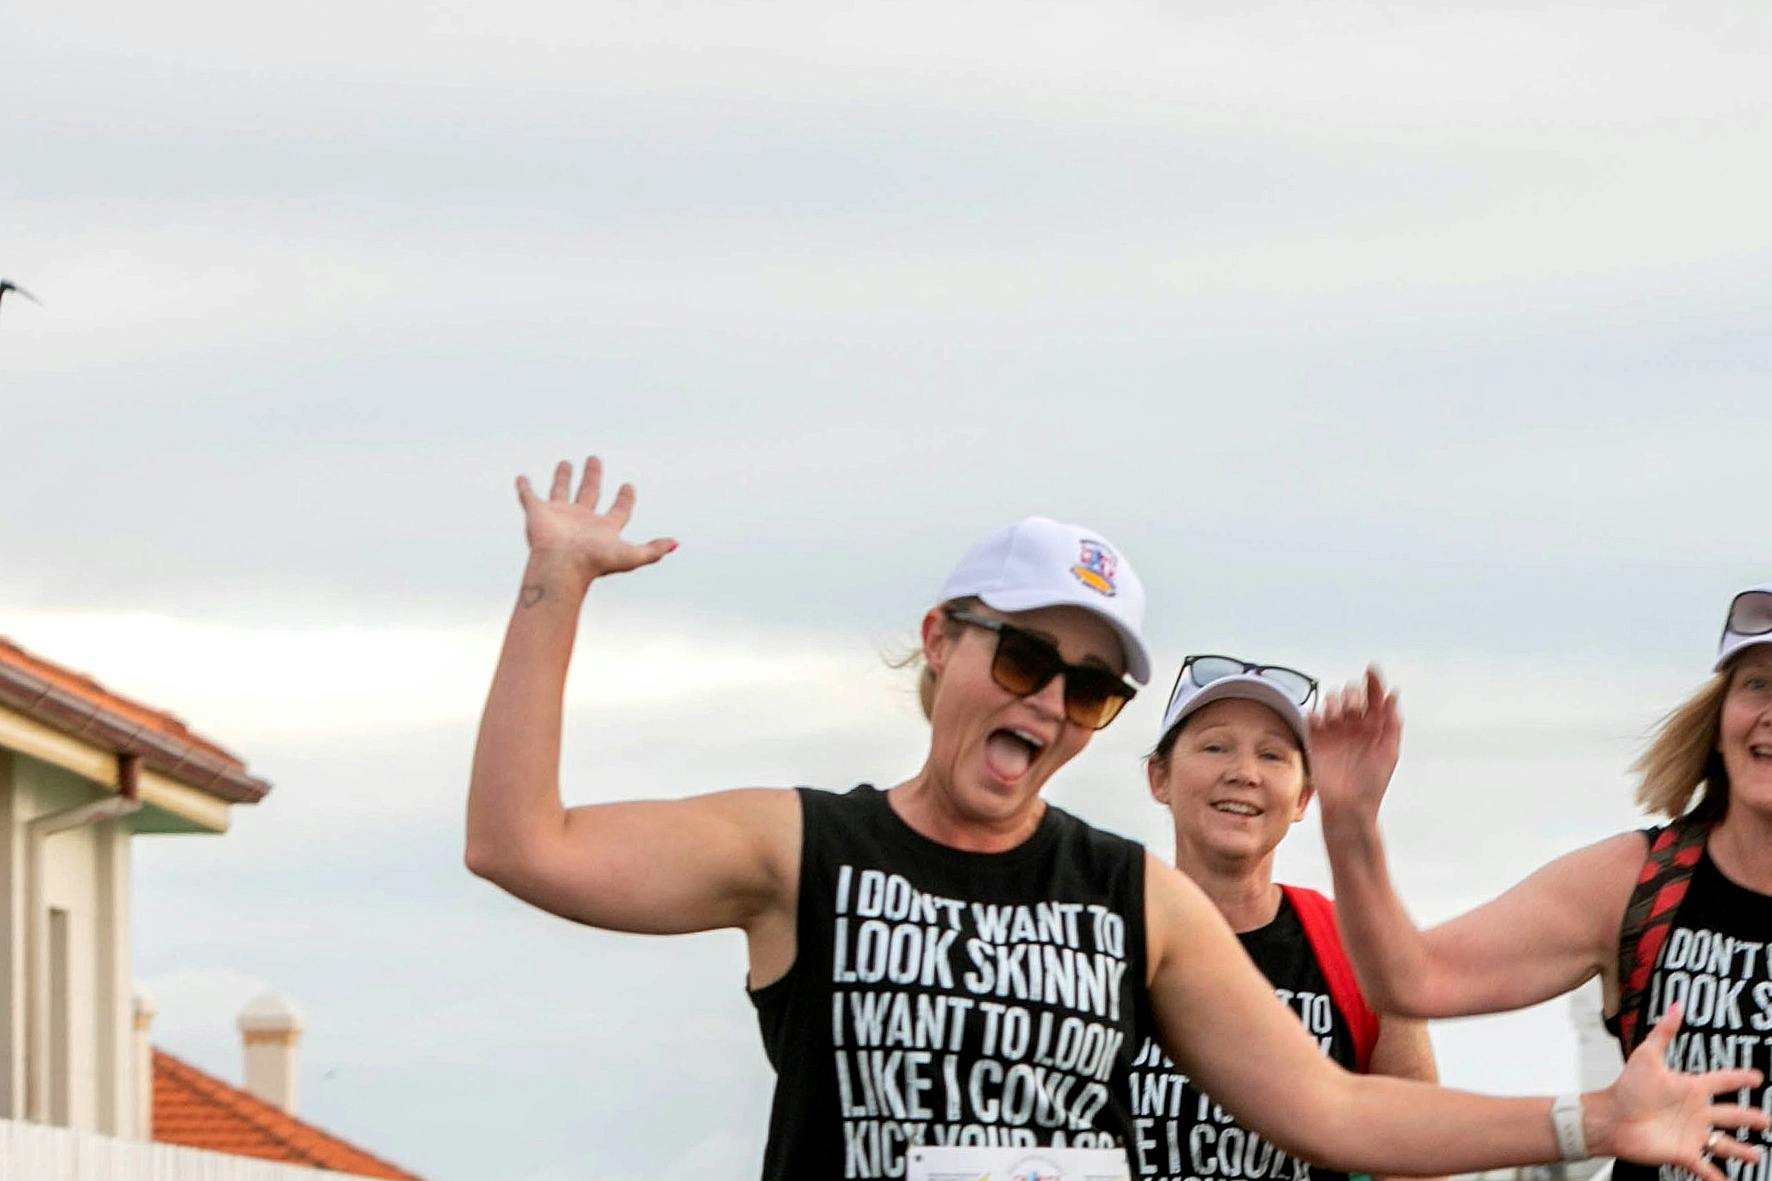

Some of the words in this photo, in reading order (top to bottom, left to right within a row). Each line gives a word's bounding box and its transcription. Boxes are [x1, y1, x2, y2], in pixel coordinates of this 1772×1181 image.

[836, 865, 853, 915] I
[970, 901, 1084, 950] WANT
[1087, 904, 1126, 960] TO
[832, 917, 959, 989] LOOK
[962, 937, 1127, 1022] SKINNY
[1663, 927, 1763, 981] DON'T
[1296, 991, 1333, 1034] TO
[1646, 970, 1748, 1030] LOOK
[832, 991, 845, 1048] I
[850, 991, 975, 1052] WANT
[979, 1002, 1032, 1060] TO
[1034, 1012, 1124, 1083] LOOK
[834, 1049, 934, 1120] LIKE
[942, 1054, 962, 1122] I
